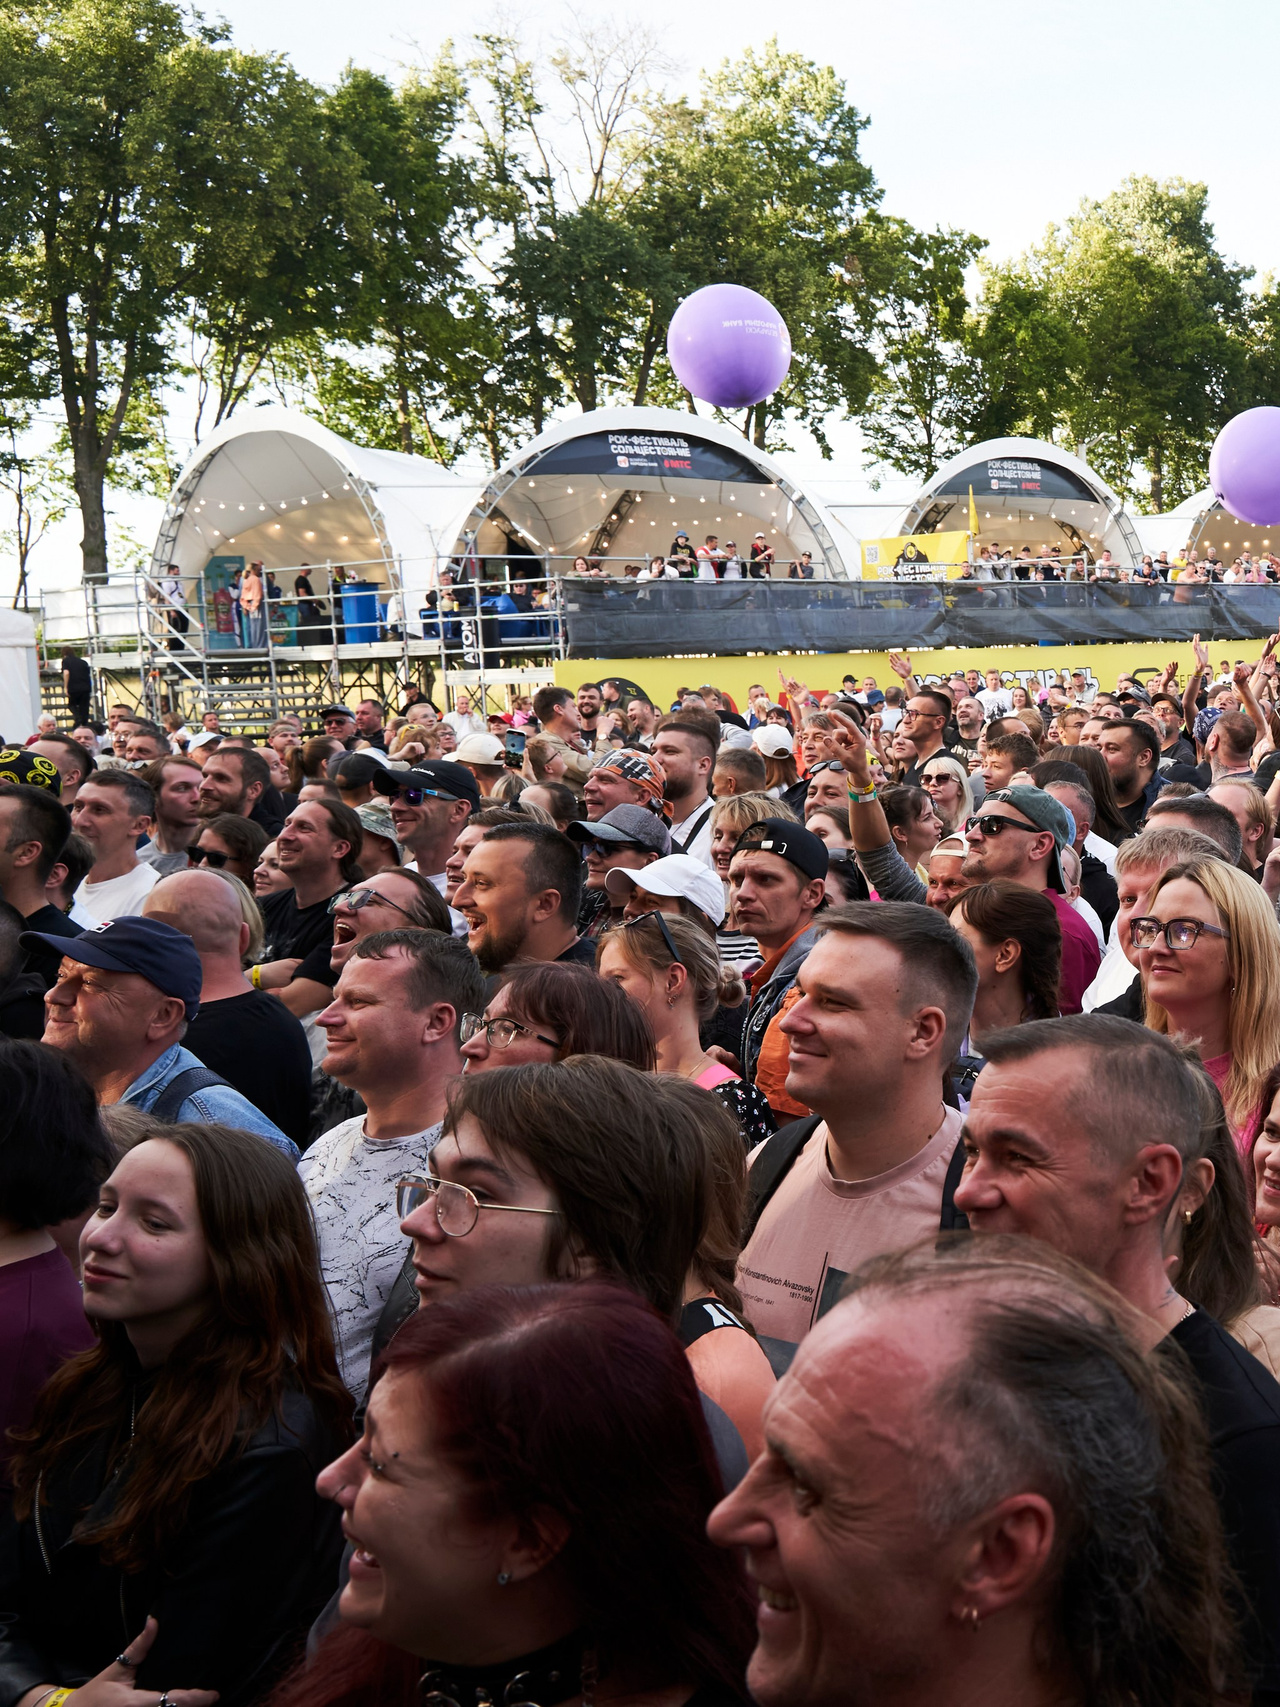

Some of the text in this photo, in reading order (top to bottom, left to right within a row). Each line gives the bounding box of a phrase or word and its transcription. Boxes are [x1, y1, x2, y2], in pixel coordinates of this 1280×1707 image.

[608, 434, 689, 447] РОК-ФЕСТИВАЛЬ
[610, 445, 691, 457] СОЛНЦЕСТОЯНИЕ
[987, 461, 1041, 471] РОК-ФЕСТИВАЛЬ
[782, 1279, 815, 1296] Aivazovsky
